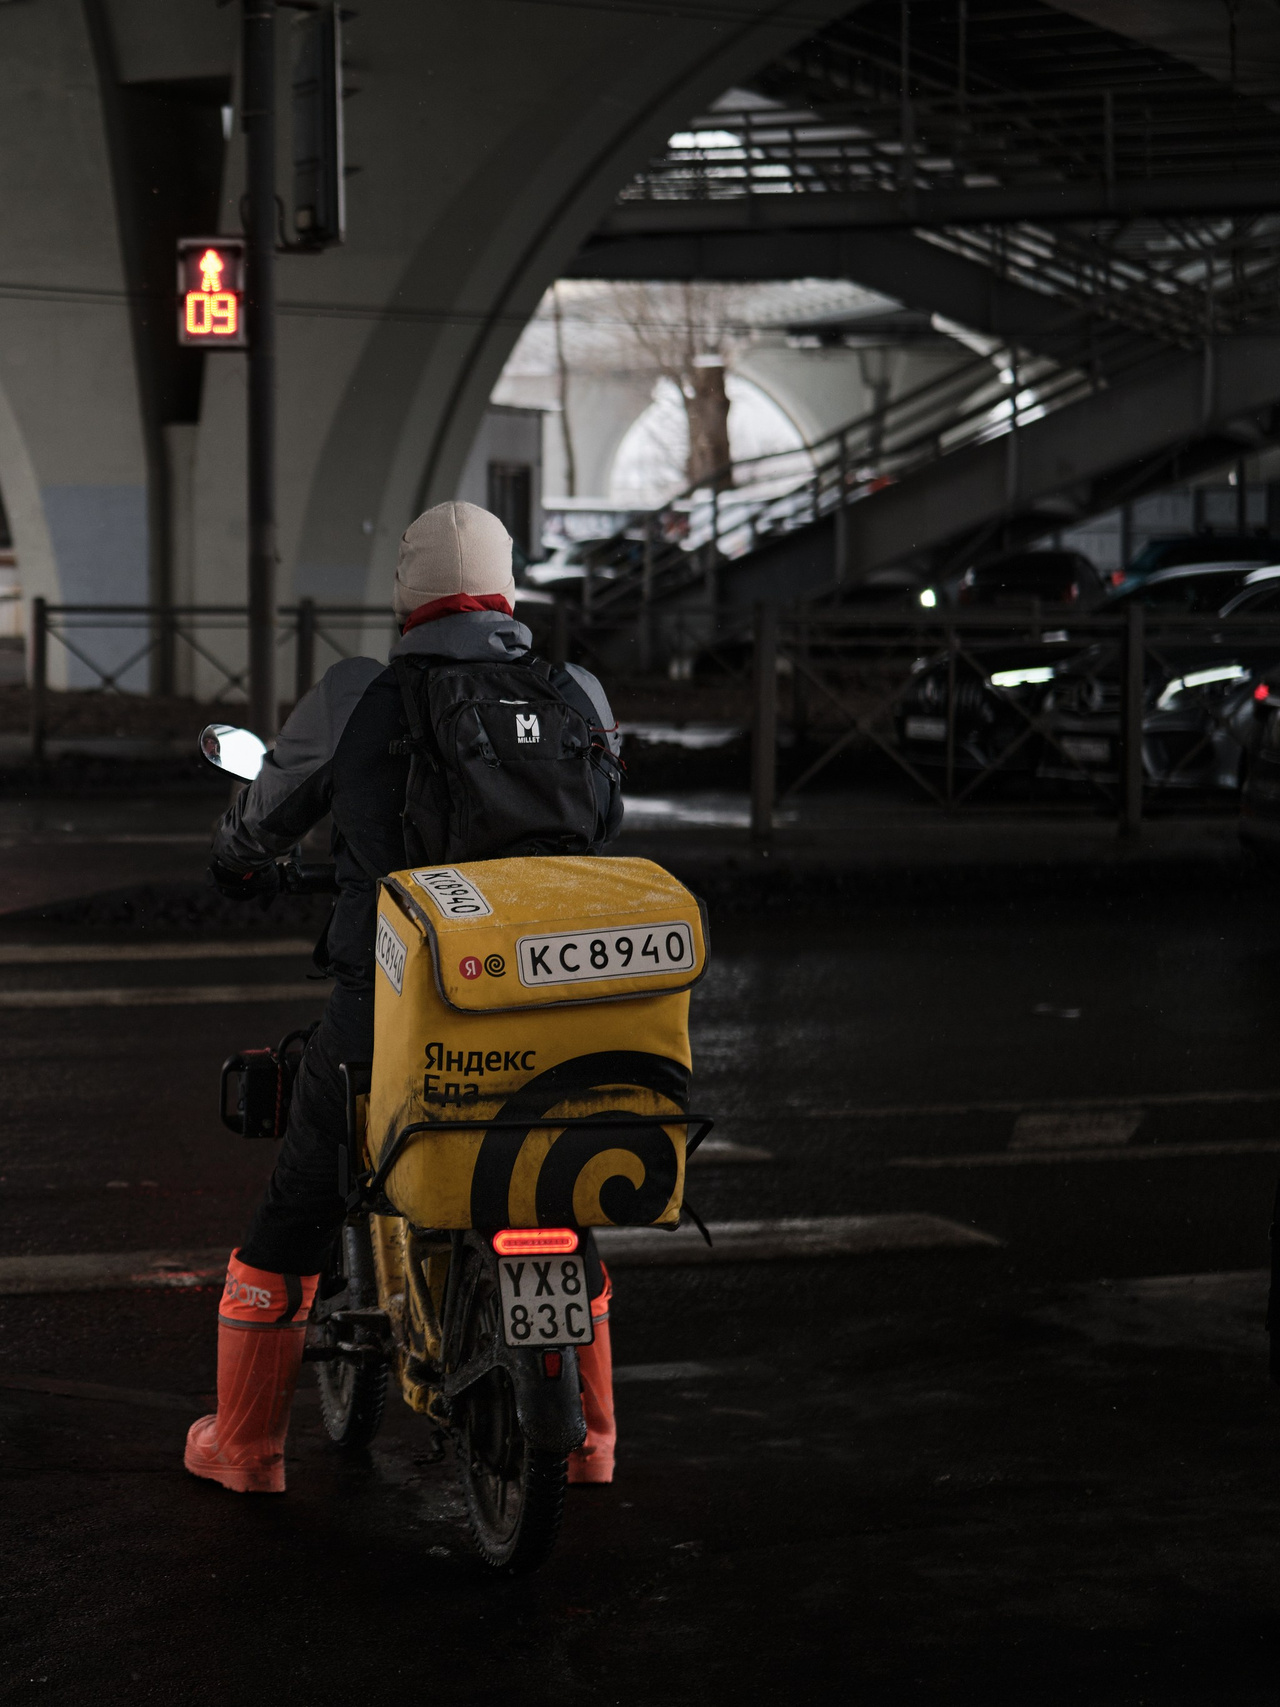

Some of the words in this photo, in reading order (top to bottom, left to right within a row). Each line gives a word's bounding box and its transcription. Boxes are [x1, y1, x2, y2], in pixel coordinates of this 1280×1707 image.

[186, 293, 237, 334] 09
[518, 736, 540, 744] MILLET
[422, 871, 480, 914] KC8940
[529, 931, 685, 976] KC8940
[424, 1042, 536, 1076] Яндекс
[424, 1074, 479, 1107] Еда
[503, 1261, 581, 1297] YX8
[510, 1303, 585, 1340] 83C
